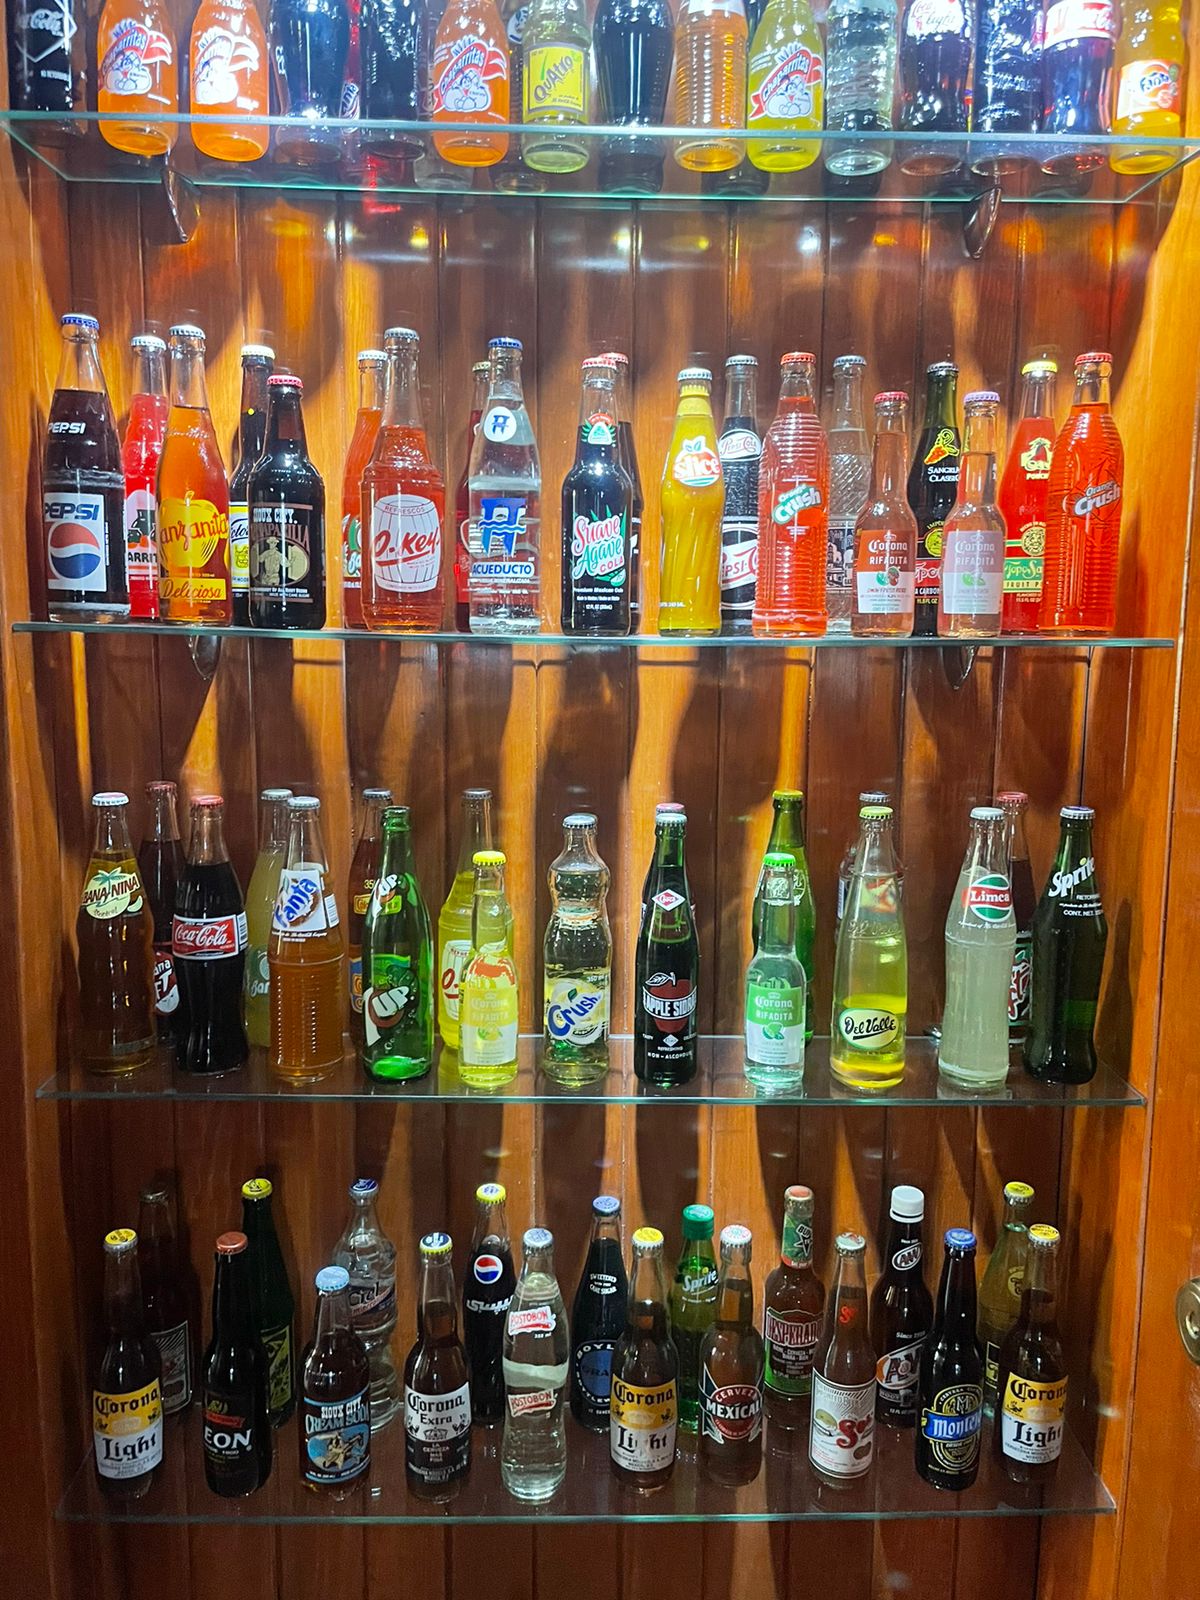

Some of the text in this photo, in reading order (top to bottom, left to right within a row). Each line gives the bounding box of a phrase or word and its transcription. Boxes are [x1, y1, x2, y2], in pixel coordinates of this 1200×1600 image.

[384, 505, 425, 515] REFESCOS
[774, 487, 821, 522] Crush
[1074, 483, 1121, 515] Crush
[161, 512, 229, 552] anzanita
[573, 515, 621, 553] Suave
[573, 535, 623, 579] Agave
[868, 539, 908, 554] Corona
[472, 564, 533, 575] ACUEDUCTO
[600, 556, 624, 573] COLA
[163, 579, 222, 599] Deliciosa
[274, 877, 318, 929] Fanta
[969, 889, 1010, 903] Limca
[754, 995, 794, 1010] Corona
[547, 996, 599, 1037] Crush
[576, 1343, 614, 1360] BOYL
[95, 1388, 158, 1418] Corona
[408, 1392, 465, 1414] Corona
[613, 1380, 673, 1405] Corona
[420, 1413, 452, 1425] Extra
[706, 1398, 760, 1420] MEXÍCAL
[102, 1432, 156, 1462] Light
[204, 1425, 252, 1449] EON
[618, 1425, 667, 1454] Liht
